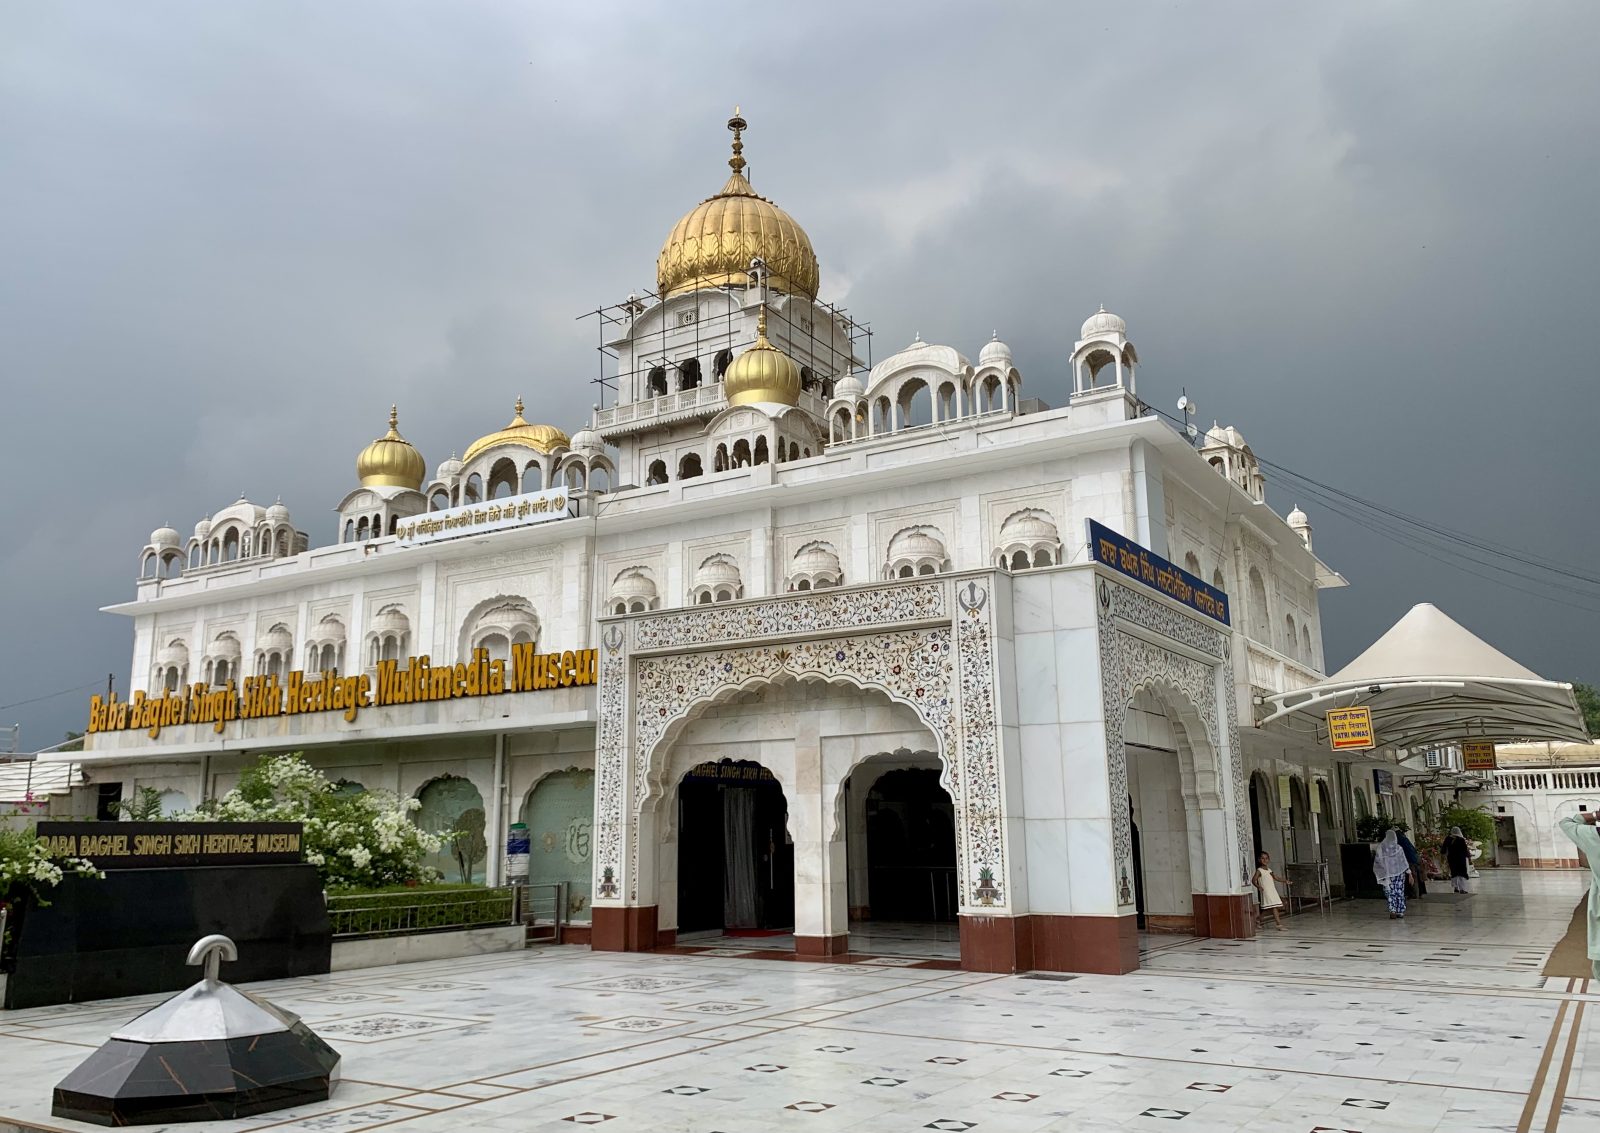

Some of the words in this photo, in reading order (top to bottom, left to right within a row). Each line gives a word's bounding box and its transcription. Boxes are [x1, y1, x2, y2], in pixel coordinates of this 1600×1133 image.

[1099, 538, 1117, 566] ਬਾਬਾ
[1119, 543, 1139, 577] ਬਘੇਲ
[88, 691, 128, 734] Baba
[130, 684, 192, 740] Baghel
[190, 678, 239, 734] Singh
[240, 673, 283, 719] Sikh
[285, 667, 370, 722] Heritage
[374, 647, 506, 706] Multimedia
[1334, 731, 1350, 739] YATRI
[1351, 730, 1369, 738] NIWAS
[720, 765, 742, 779] SINGH
[743, 766, 759, 780] SIKH
[80, 835, 131, 857] BAGHEL
[133, 834, 171, 855] SINGH
[174, 834, 200, 854] SIKH
[202, 833, 255, 854] HERITAGE
[256, 833, 300, 853] MUSEUM
